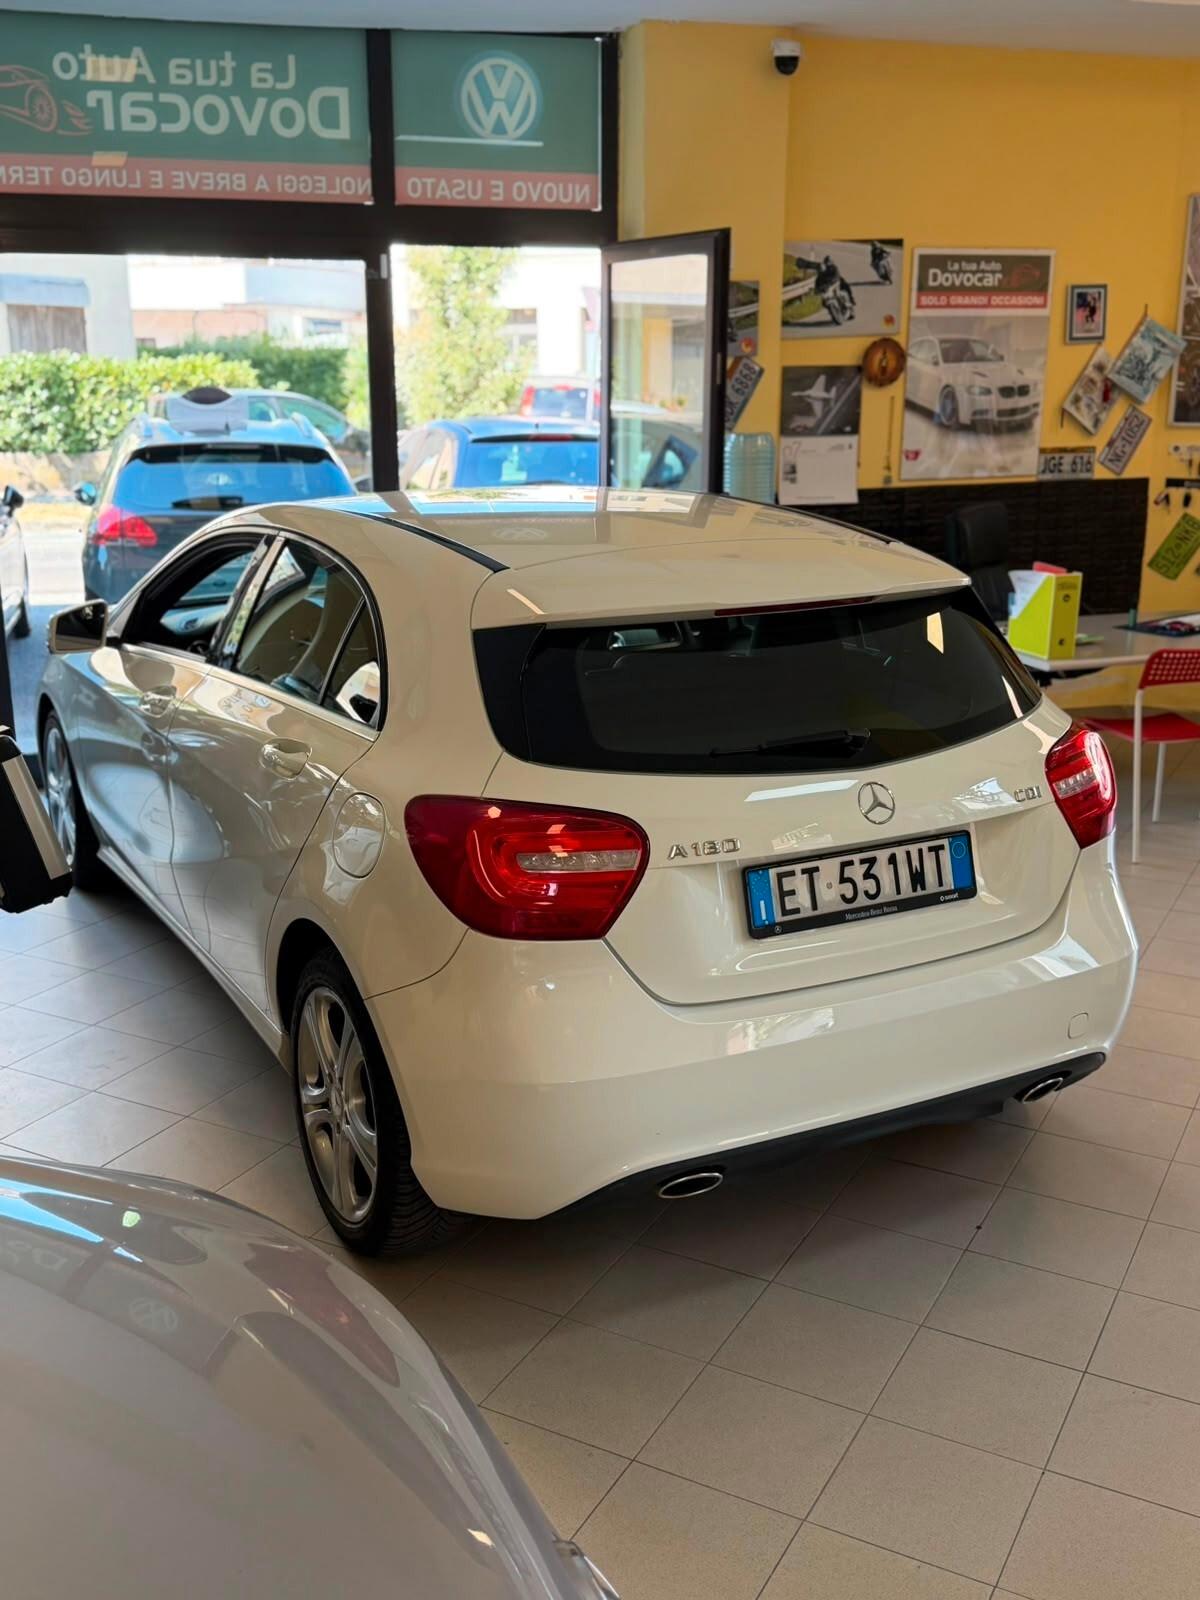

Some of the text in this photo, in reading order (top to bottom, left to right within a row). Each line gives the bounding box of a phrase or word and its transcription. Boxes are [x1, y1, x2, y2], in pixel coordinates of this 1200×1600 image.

[947, 260, 1002, 272] La tua Auto
[928, 267, 1003, 288] Dovocar
[921, 295, 948, 306] SOLO
[990, 294, 1044, 306] OCCASIONI
[1013, 786, 1042, 802] CDI
[776, 866, 821, 917] ET
[838, 844, 946, 905] 531WT
